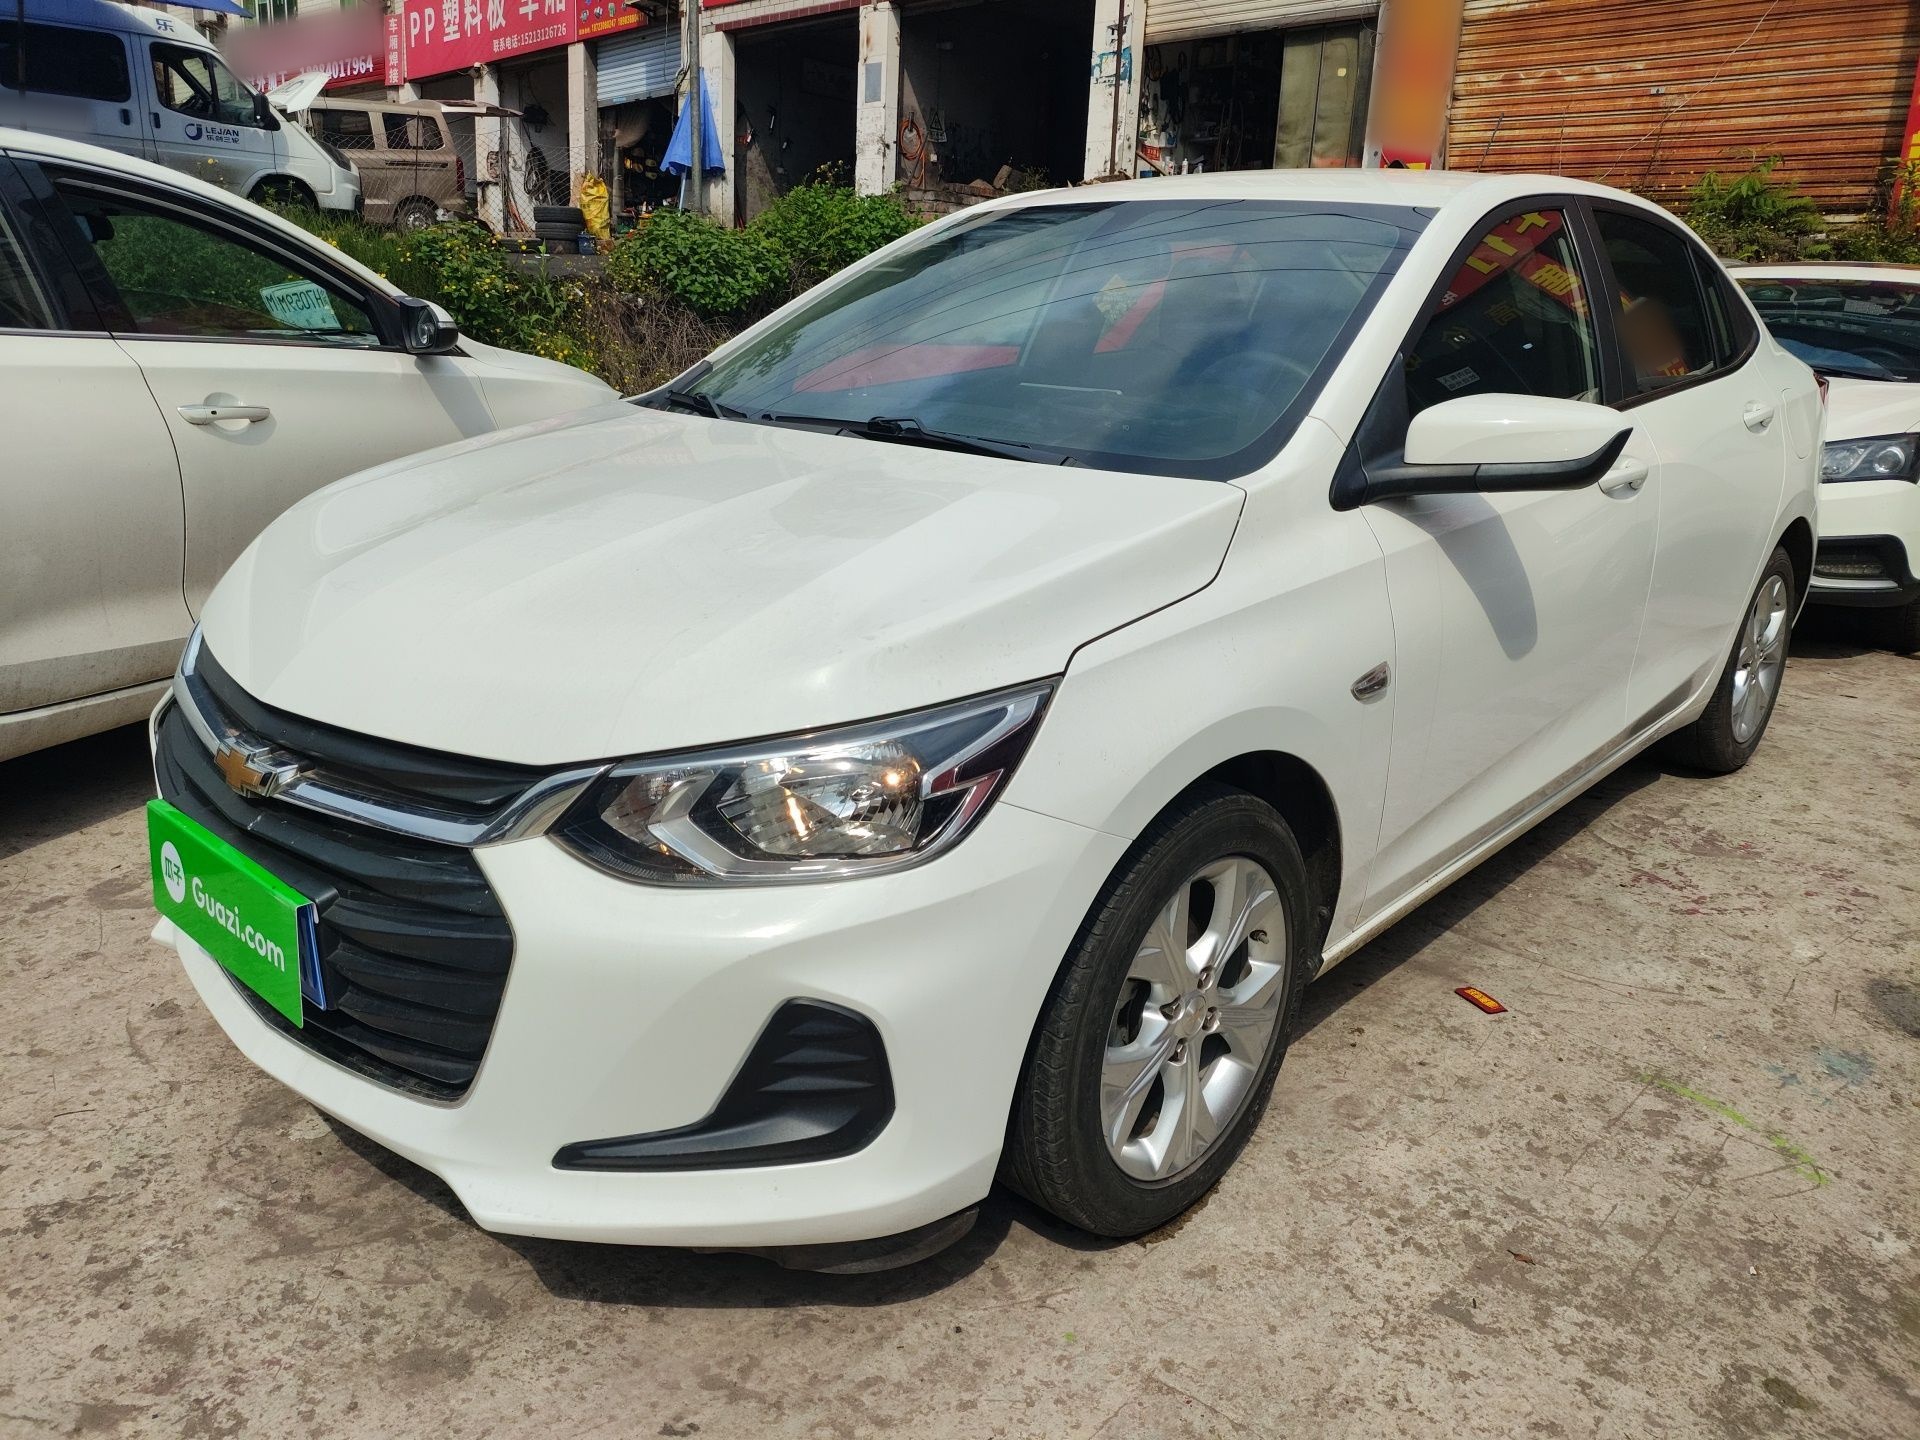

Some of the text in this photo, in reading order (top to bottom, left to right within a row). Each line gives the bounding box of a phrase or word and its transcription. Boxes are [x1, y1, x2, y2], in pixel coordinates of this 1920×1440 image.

[156, 18, 175, 33] 乐
[389, 17, 399, 84] 车厢焊接
[164, 856, 183, 887] 瓜子
[191, 876, 286, 973] Guazi.com
